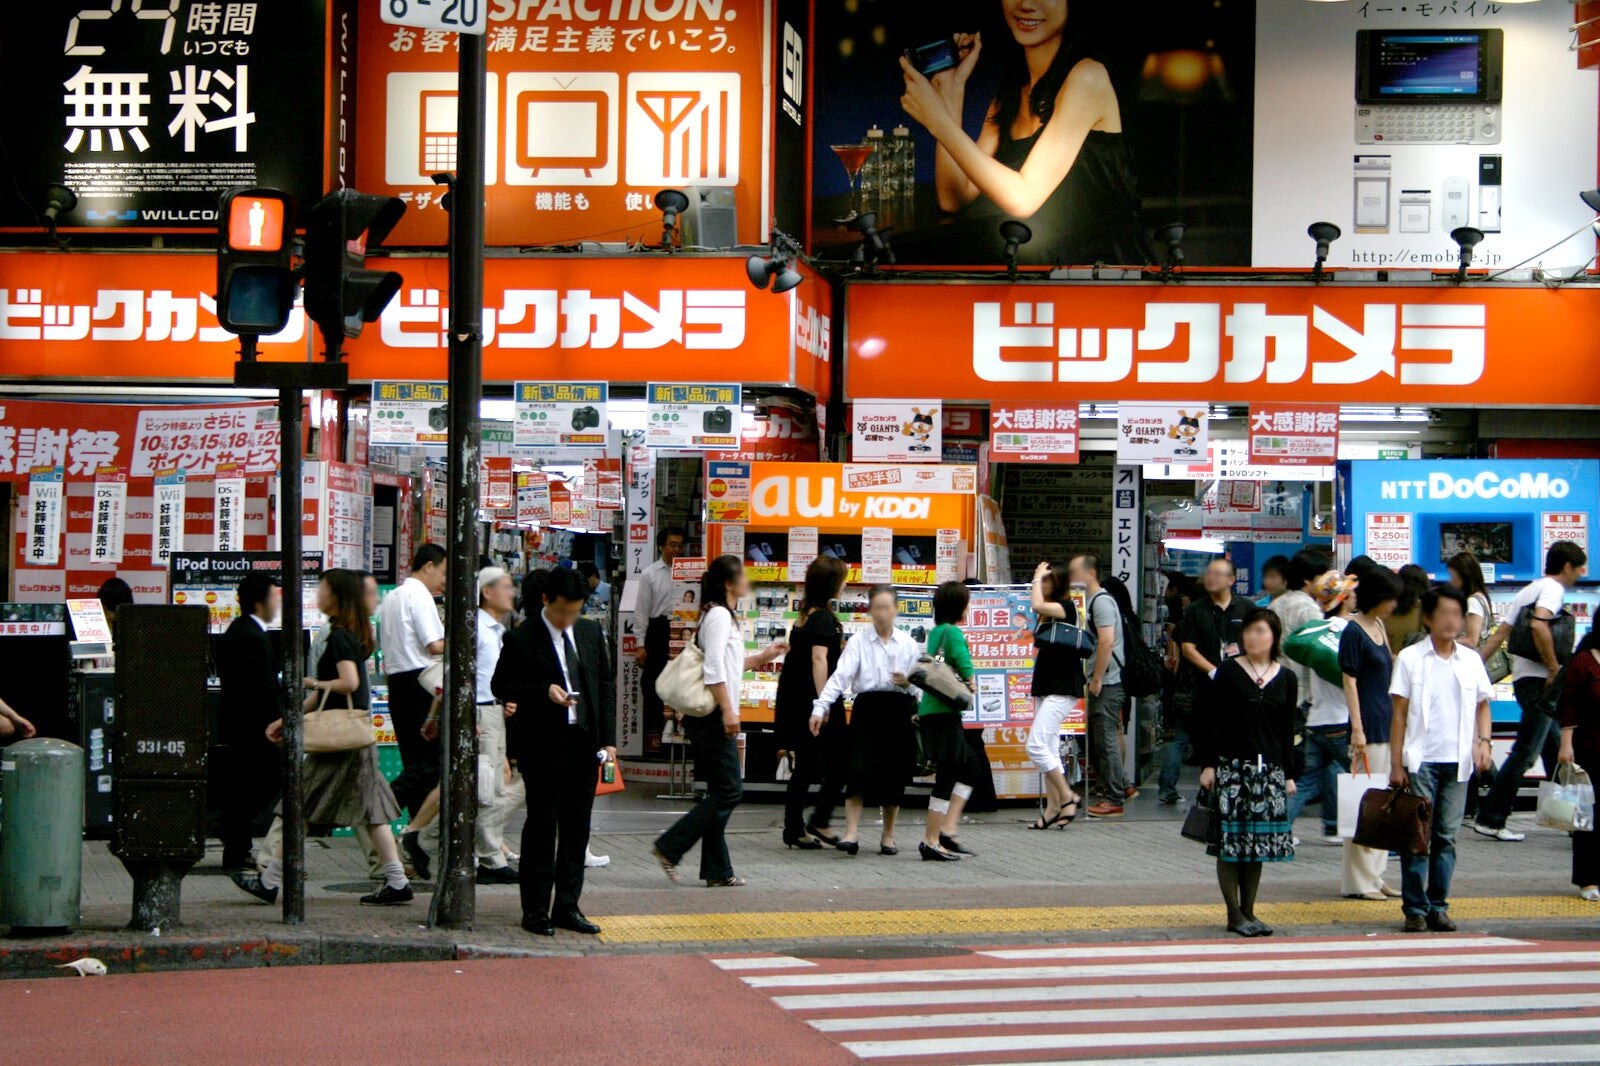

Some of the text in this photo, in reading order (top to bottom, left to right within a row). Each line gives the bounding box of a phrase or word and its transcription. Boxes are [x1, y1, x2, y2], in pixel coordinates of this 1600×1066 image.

[186, 3, 257, 35] 時間
[1357, 2, 1501, 18] イー・モバイル
[183, 40, 250, 56] いつでも
[389, 25, 736, 53] お客満足主義でいこう。
[63, 65, 256, 153] 無料
[535, 192, 590, 211] 機能も
[1352, 249, 1502, 265] http://emobie.jp
[0, 288, 303, 342] ビックカ
[973, 302, 1485, 385] ビックカメラ
[204, 416, 246, 430] さらに
[870, 424, 900, 433] GIANTS
[993, 409, 1077, 430] 大感謝祭
[1251, 411, 1338, 433] 大感謝祭
[1135, 426, 1166, 435] GIANTS
[36, 488, 57, 498] Wii
[160, 490, 180, 500] Wii
[1381, 471, 1570, 499] NTT DoCoMo
[753, 476, 835, 518] au
[839, 496, 931, 519] by KDDI
[33, 500, 47, 559] 好評販売中
[95, 500, 110, 558] 好評販売中
[159, 503, 171, 560] 好評販売中
[176, 558, 209, 571] iPod
[212, 558, 250, 570] touch
[967, 643, 1034, 657] !見る!残す!
[137, 740, 186, 757] 331-05
